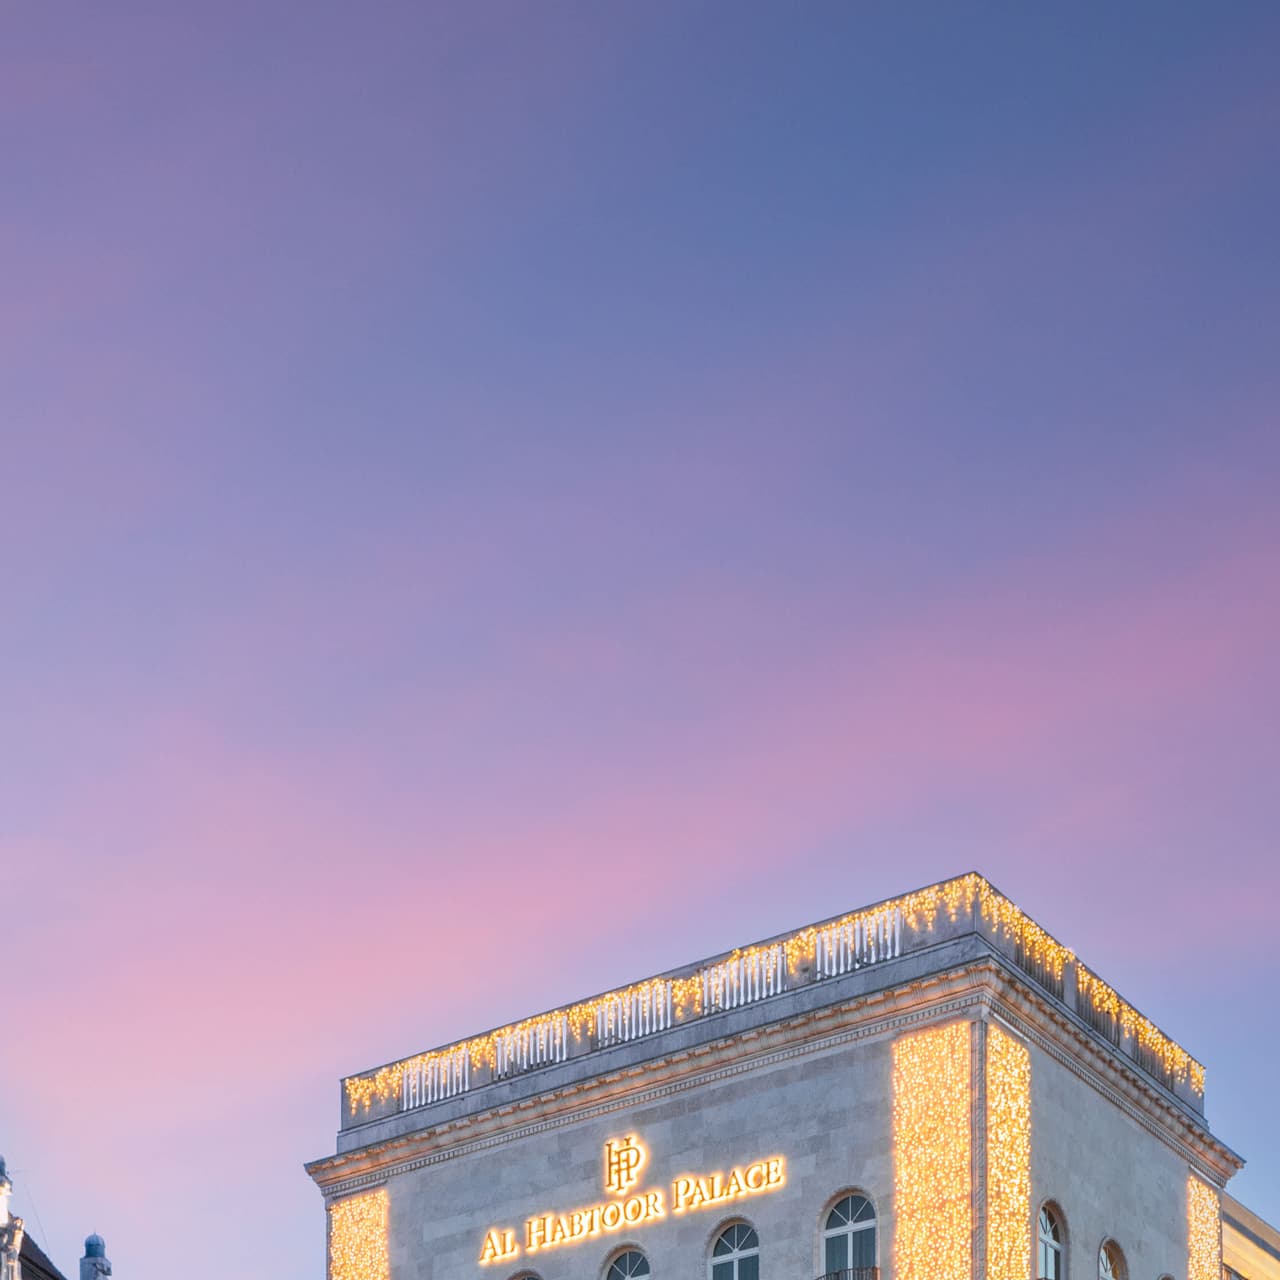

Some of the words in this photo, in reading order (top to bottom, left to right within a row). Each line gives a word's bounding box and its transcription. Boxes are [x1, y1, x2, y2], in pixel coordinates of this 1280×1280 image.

[479, 1229, 518, 1263] AL
[526, 1191, 664, 1249] HABTOOR
[672, 1158, 785, 1211] PALACE
